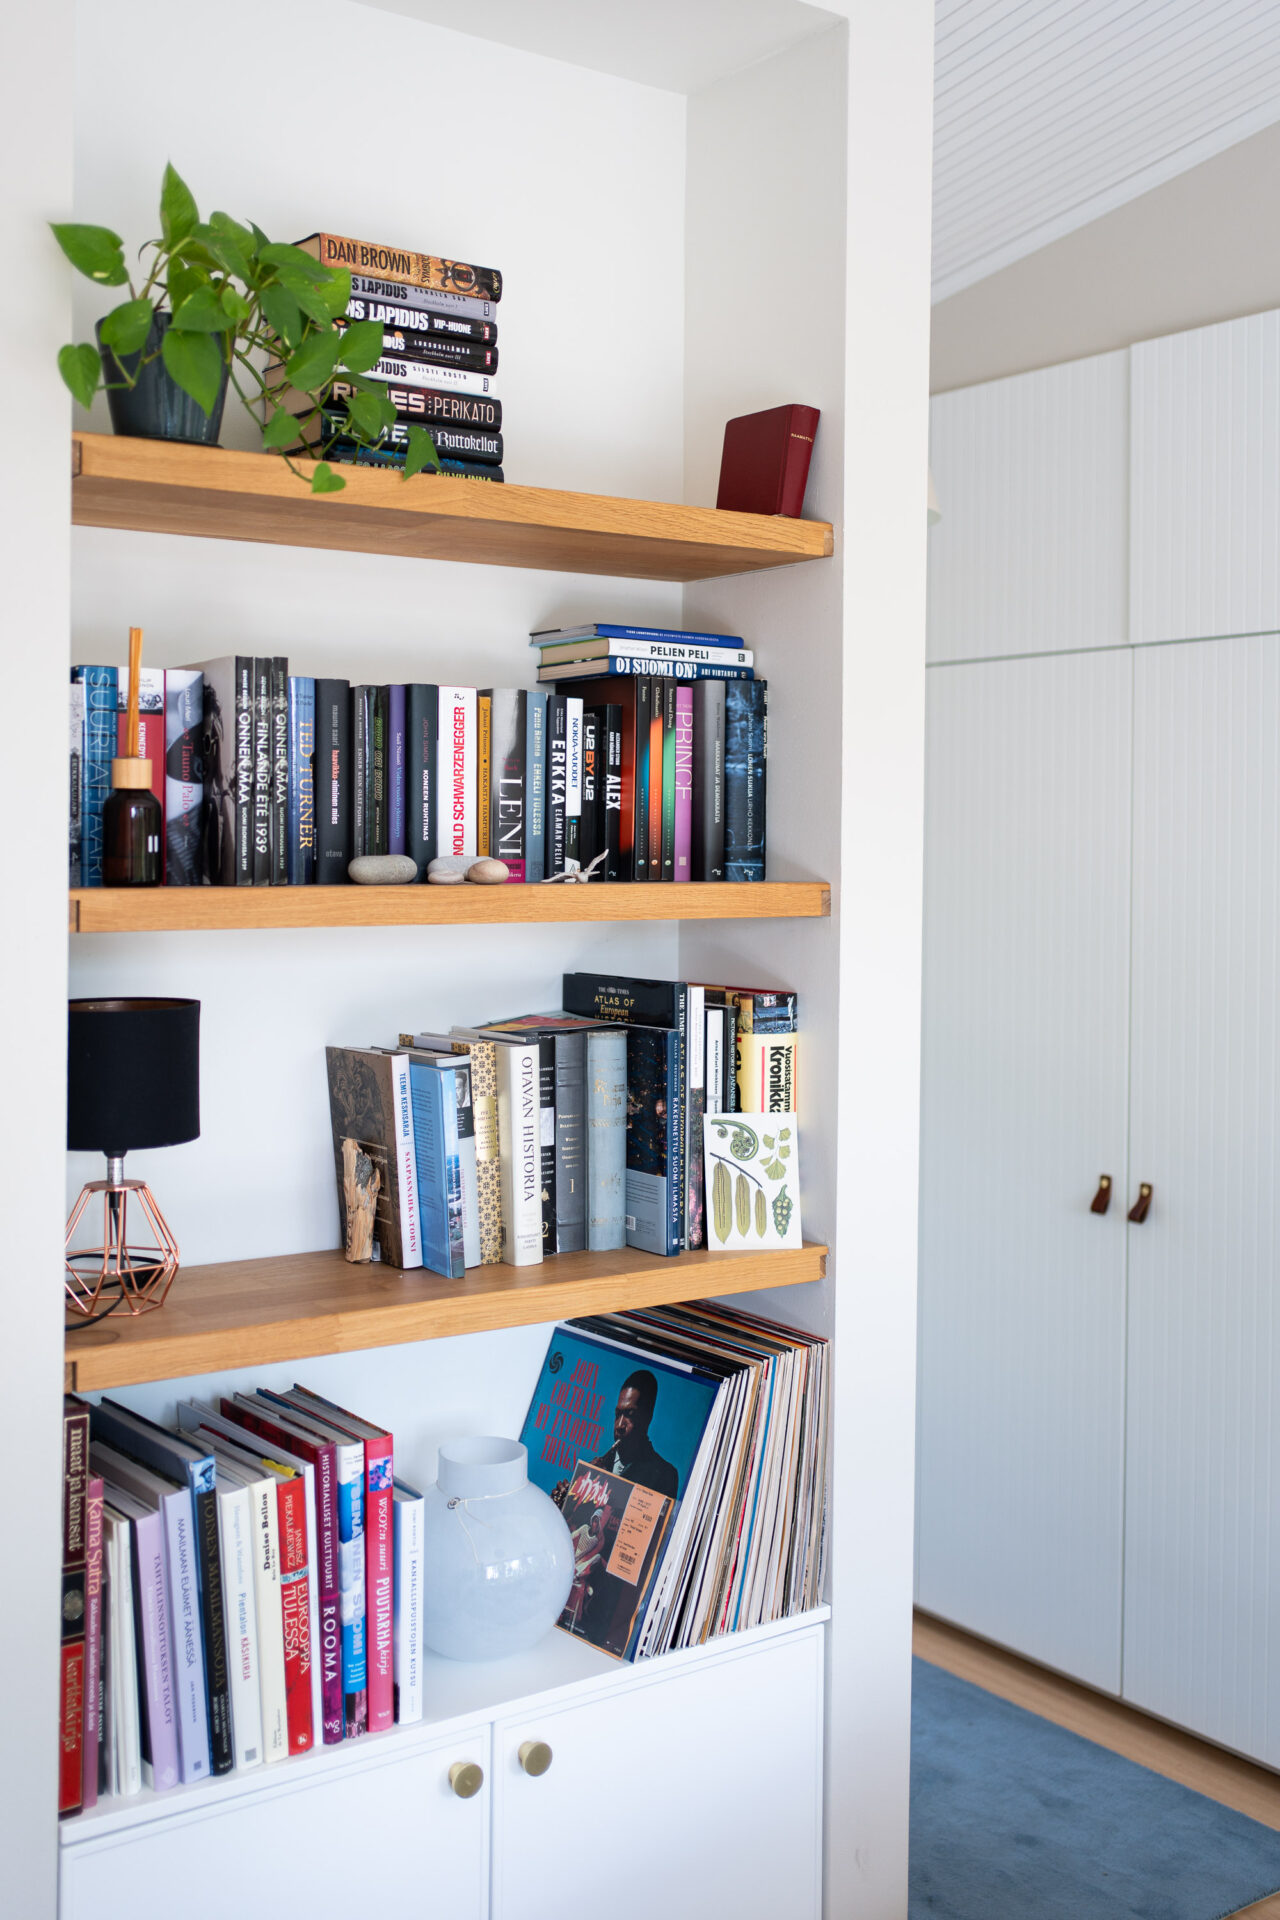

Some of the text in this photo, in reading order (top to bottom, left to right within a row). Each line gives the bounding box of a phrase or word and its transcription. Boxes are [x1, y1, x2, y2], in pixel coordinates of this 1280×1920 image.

[327, 239, 358, 262] DAN
[361, 246, 411, 275] BROWN
[362, 277, 408, 299] LAPIDUS
[368, 303, 472, 335] LAPIDUS VIP-HUONE
[434, 396, 494, 424] PERIKATO
[437, 430, 499, 454] Ruttokellot
[616, 657, 630, 674] OI
[632, 658, 674, 677] SUOMI
[676, 663, 698, 679] ON!
[650, 646, 685, 658] PELIEN
[688, 650, 709, 660] PELI
[90, 672, 110, 754] SUURI
[238, 713, 251, 767] ONNEN
[275, 713, 288, 767] ONNEN
[300, 718, 313, 758] TED
[181, 742, 194, 810] Tauno Palo
[452, 706, 465, 820] SCHWARZENEGGER
[552, 740, 565, 805] ERKKA
[571, 718, 579, 788] NOKIA-VUODET
[238, 771, 251, 804] MAA
[256, 722, 270, 854] FINLANDE ÉTÉ 1939
[275, 771, 288, 804] MAA
[300, 764, 313, 849] TURNER
[606, 774, 620, 810] ALEX
[331, 808, 340, 824] mies
[452, 823, 464, 856] NOLD
[499, 776, 522, 856] LENI
[594, 995, 635, 1007] ATLAS OF
[600, 1004, 629, 1018] European
[400, 1072, 410, 1138] TEEMU KESKISARJA
[521, 1056, 536, 1202] OTAVAN HISTORIA
[404, 1151, 417, 1253] SAAPASNAHKA-TORNI
[68, 1427, 84, 1472] maat
[66, 1490, 83, 1552] kansat
[261, 1493, 271, 1571] Denise Bellon
[284, 1494, 296, 1568] PIEKALKIEWICZ
[378, 1496, 388, 1540] WSOY:n
[87, 1497, 103, 1596] Kama Sutra
[294, 1528, 304, 1566] JANUSZ
[321, 1454, 337, 1682] HISTORIALLISET KULTTUURIT ROOMA
[378, 1543, 389, 1571] suuri
[176, 1518, 196, 1668] MAAILMAN ELÄIMET ÄÄNESSÄ
[202, 1497, 225, 1688] TOINEN MAAILMANSOTA
[238, 1592, 248, 1635] Pientalon
[282, 1586, 298, 1662] TULESSA
[297, 1582, 311, 1675] EUROOPPA
[352, 1594, 364, 1656] SUOMI
[240, 1636, 251, 1681] KÄSIKIRJA
[410, 1658, 418, 1687] KUTSU
[64, 1655, 82, 1753] karttakirja
[161, 1680, 172, 1725] TALOT
